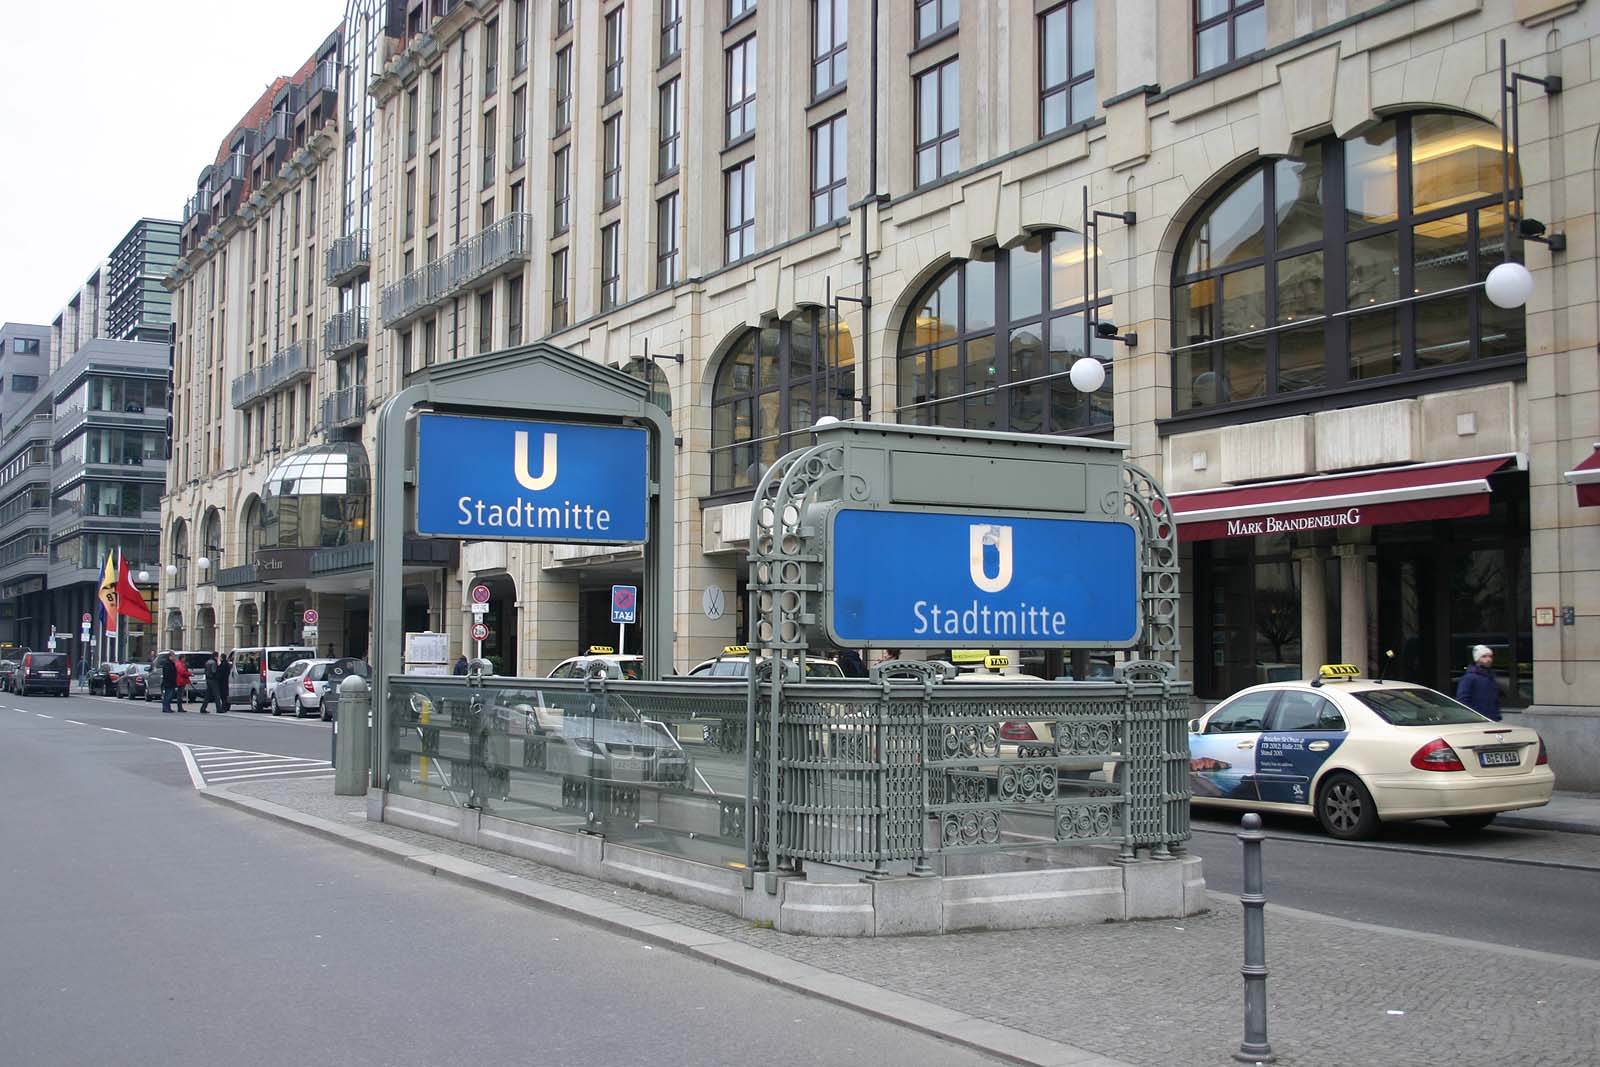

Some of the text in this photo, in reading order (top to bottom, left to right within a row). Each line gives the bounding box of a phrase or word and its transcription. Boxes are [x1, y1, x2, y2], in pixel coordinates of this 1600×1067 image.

[514, 431, 558, 491] U
[458, 496, 610, 531] Stadtmitte
[1266, 508, 1360, 533] BRANDENBURG
[970, 524, 1013, 593] U
[914, 600, 1066, 636] Stadtmitte
[991, 658, 1009, 666] TAXI
